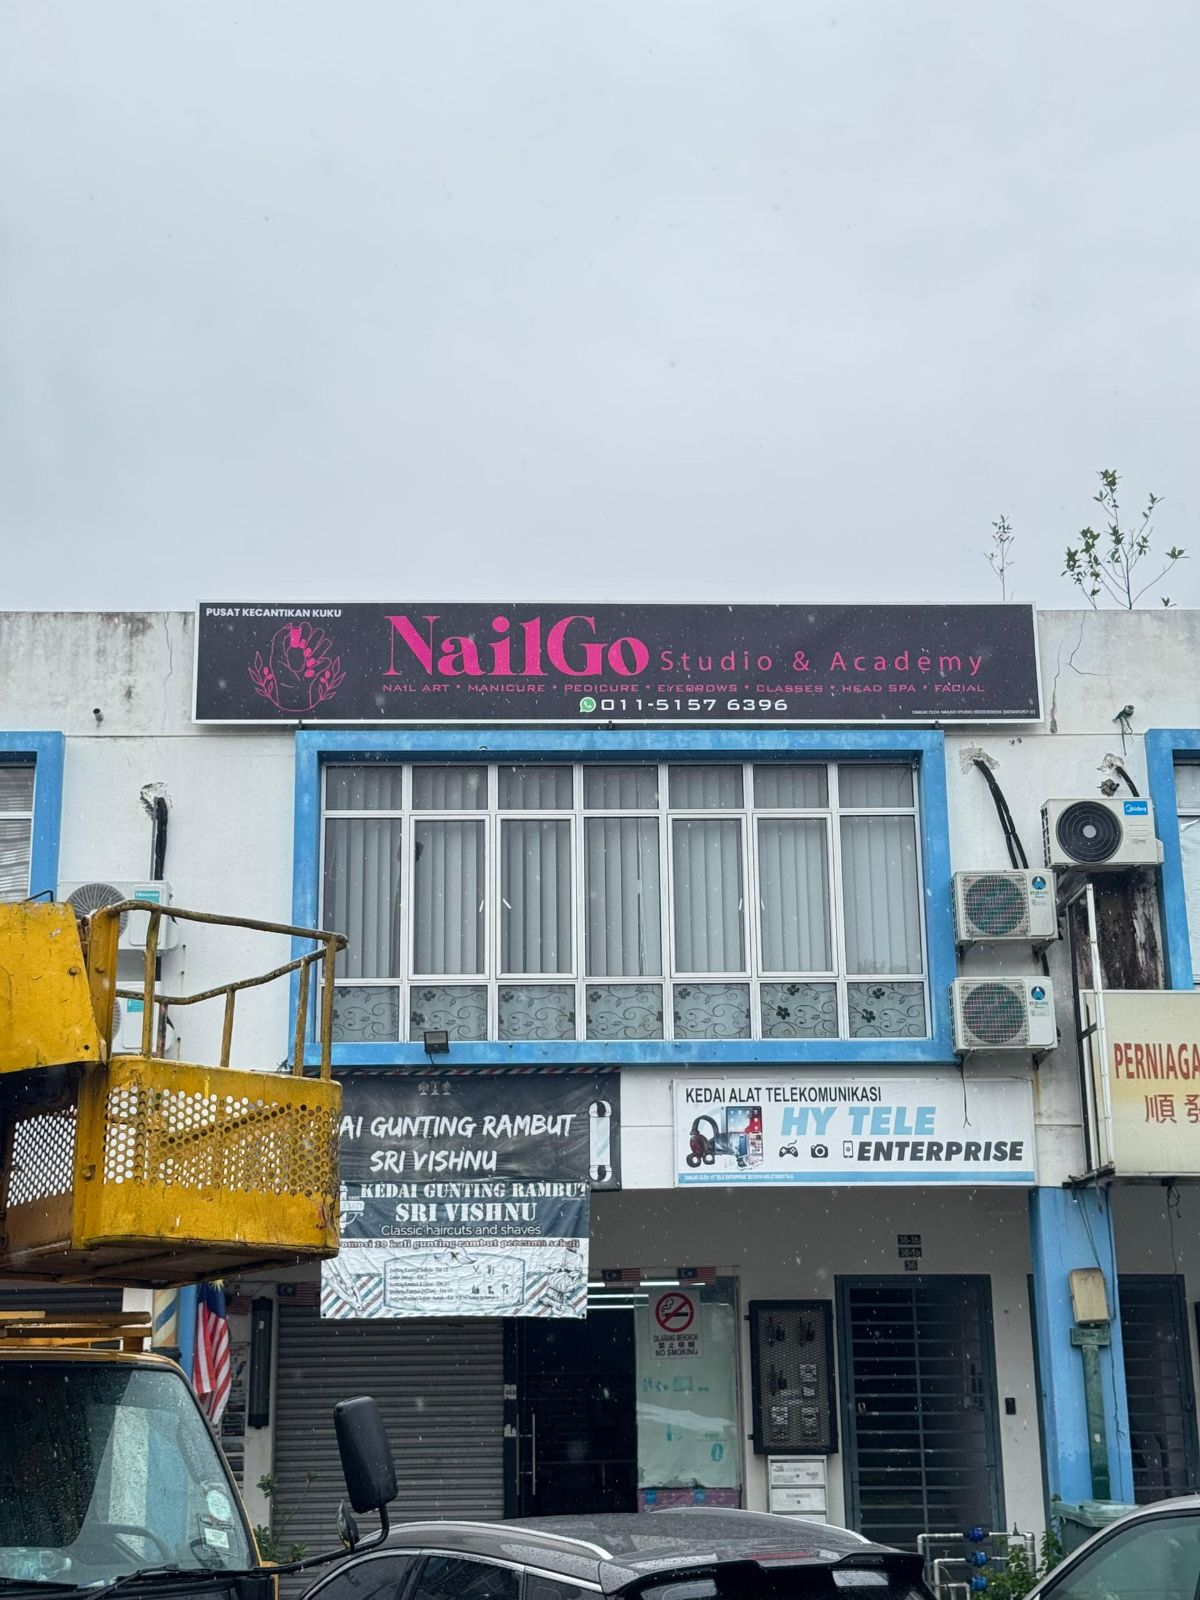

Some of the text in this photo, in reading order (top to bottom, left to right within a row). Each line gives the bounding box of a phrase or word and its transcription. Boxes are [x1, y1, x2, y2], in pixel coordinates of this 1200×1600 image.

[206, 607, 343, 618] PUSAT KECANTIKAN KUKU
[382, 615, 650, 677] NailGo
[659, 650, 983, 676] Studio & Academy
[382, 683, 985, 693] NAIL ART MANICURE PEDICURE EYEBROWS CLASSES HEAD SPA FACIAL
[601, 698, 788, 711] 011-5157 6396
[685, 1086, 882, 1103] KEDAI ALAT TELEKOMUNIKASI
[370, 1115, 477, 1139] GUNTING
[482, 1114, 577, 1138] RAMBUT
[780, 1106, 937, 1136] HY TELE
[857, 1141, 1024, 1162] ENTERPRISE
[369, 1150, 498, 1174] SRI VISHNU
[360, 1182, 588, 1198] KEDAI GUNTING RAMBUT
[395, 1202, 538, 1222] SRI VISHNU
[381, 1224, 542, 1236] Classic haircuts and shaves
[340, 1240, 373, 1248] omosi
[413, 1240, 456, 1249] gunting
[457, 1239, 498, 1248] rambut
[500, 1239, 547, 1249] percuma
[549, 1239, 580, 1248] sekali
[667, 1348, 698, 1356] SMOKING
